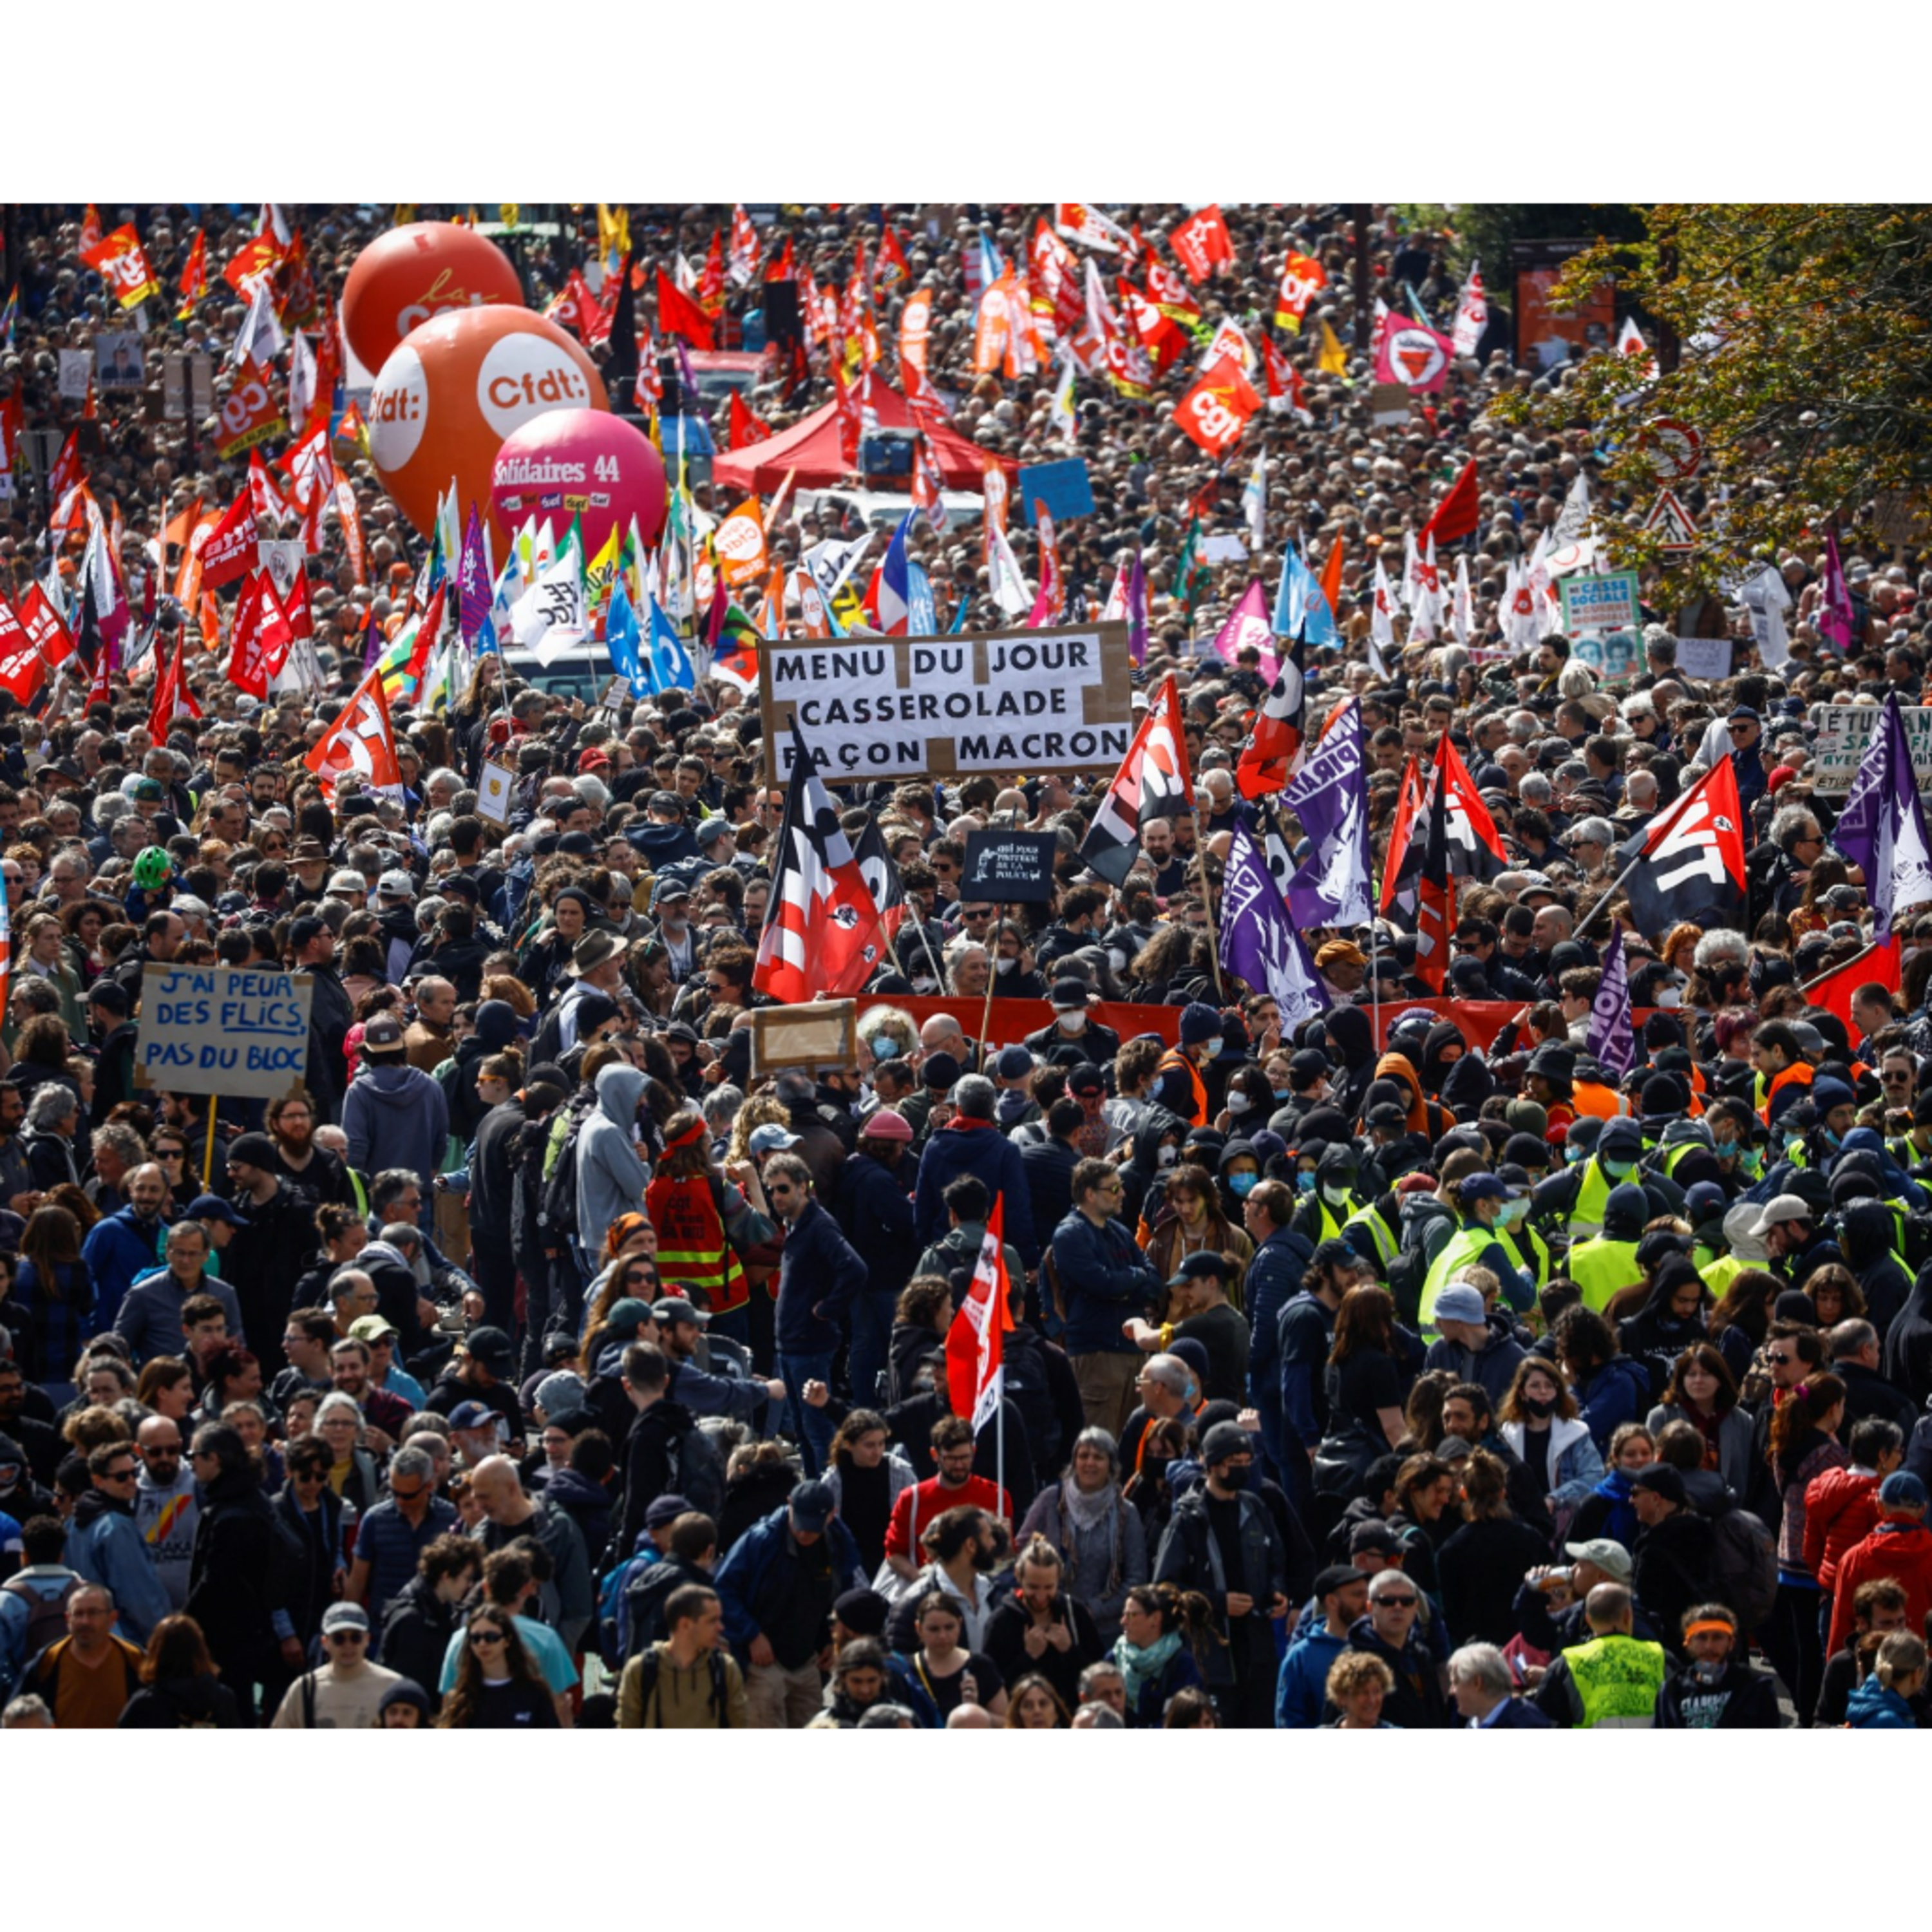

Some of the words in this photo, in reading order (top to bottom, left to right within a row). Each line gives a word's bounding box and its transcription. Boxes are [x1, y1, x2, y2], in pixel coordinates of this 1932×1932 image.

[489, 368, 584, 409] Cfdt:
[1191, 391, 1243, 443] cgt
[493, 457, 585, 487] Solidaires
[594, 455, 620, 482] 44
[1570, 592, 1629, 606] SOCIALE
[1582, 580, 1627, 594] CASSE
[1572, 613, 1633, 625] MONDIALE
[775, 649, 886, 682] MENU
[914, 648, 963, 674] DU
[992, 642, 1088, 672] JOUR
[800, 688, 1066, 726] CASSEROLADE
[784, 741, 920, 771] FAÇON
[960, 729, 1127, 761] MACRON
[227, 974, 292, 997] PEUR
[156, 1000, 209, 1025] DES
[146, 1043, 194, 1066] PAS
[199, 1044, 238, 1069] DU
[246, 1045, 305, 1071] BLOC
